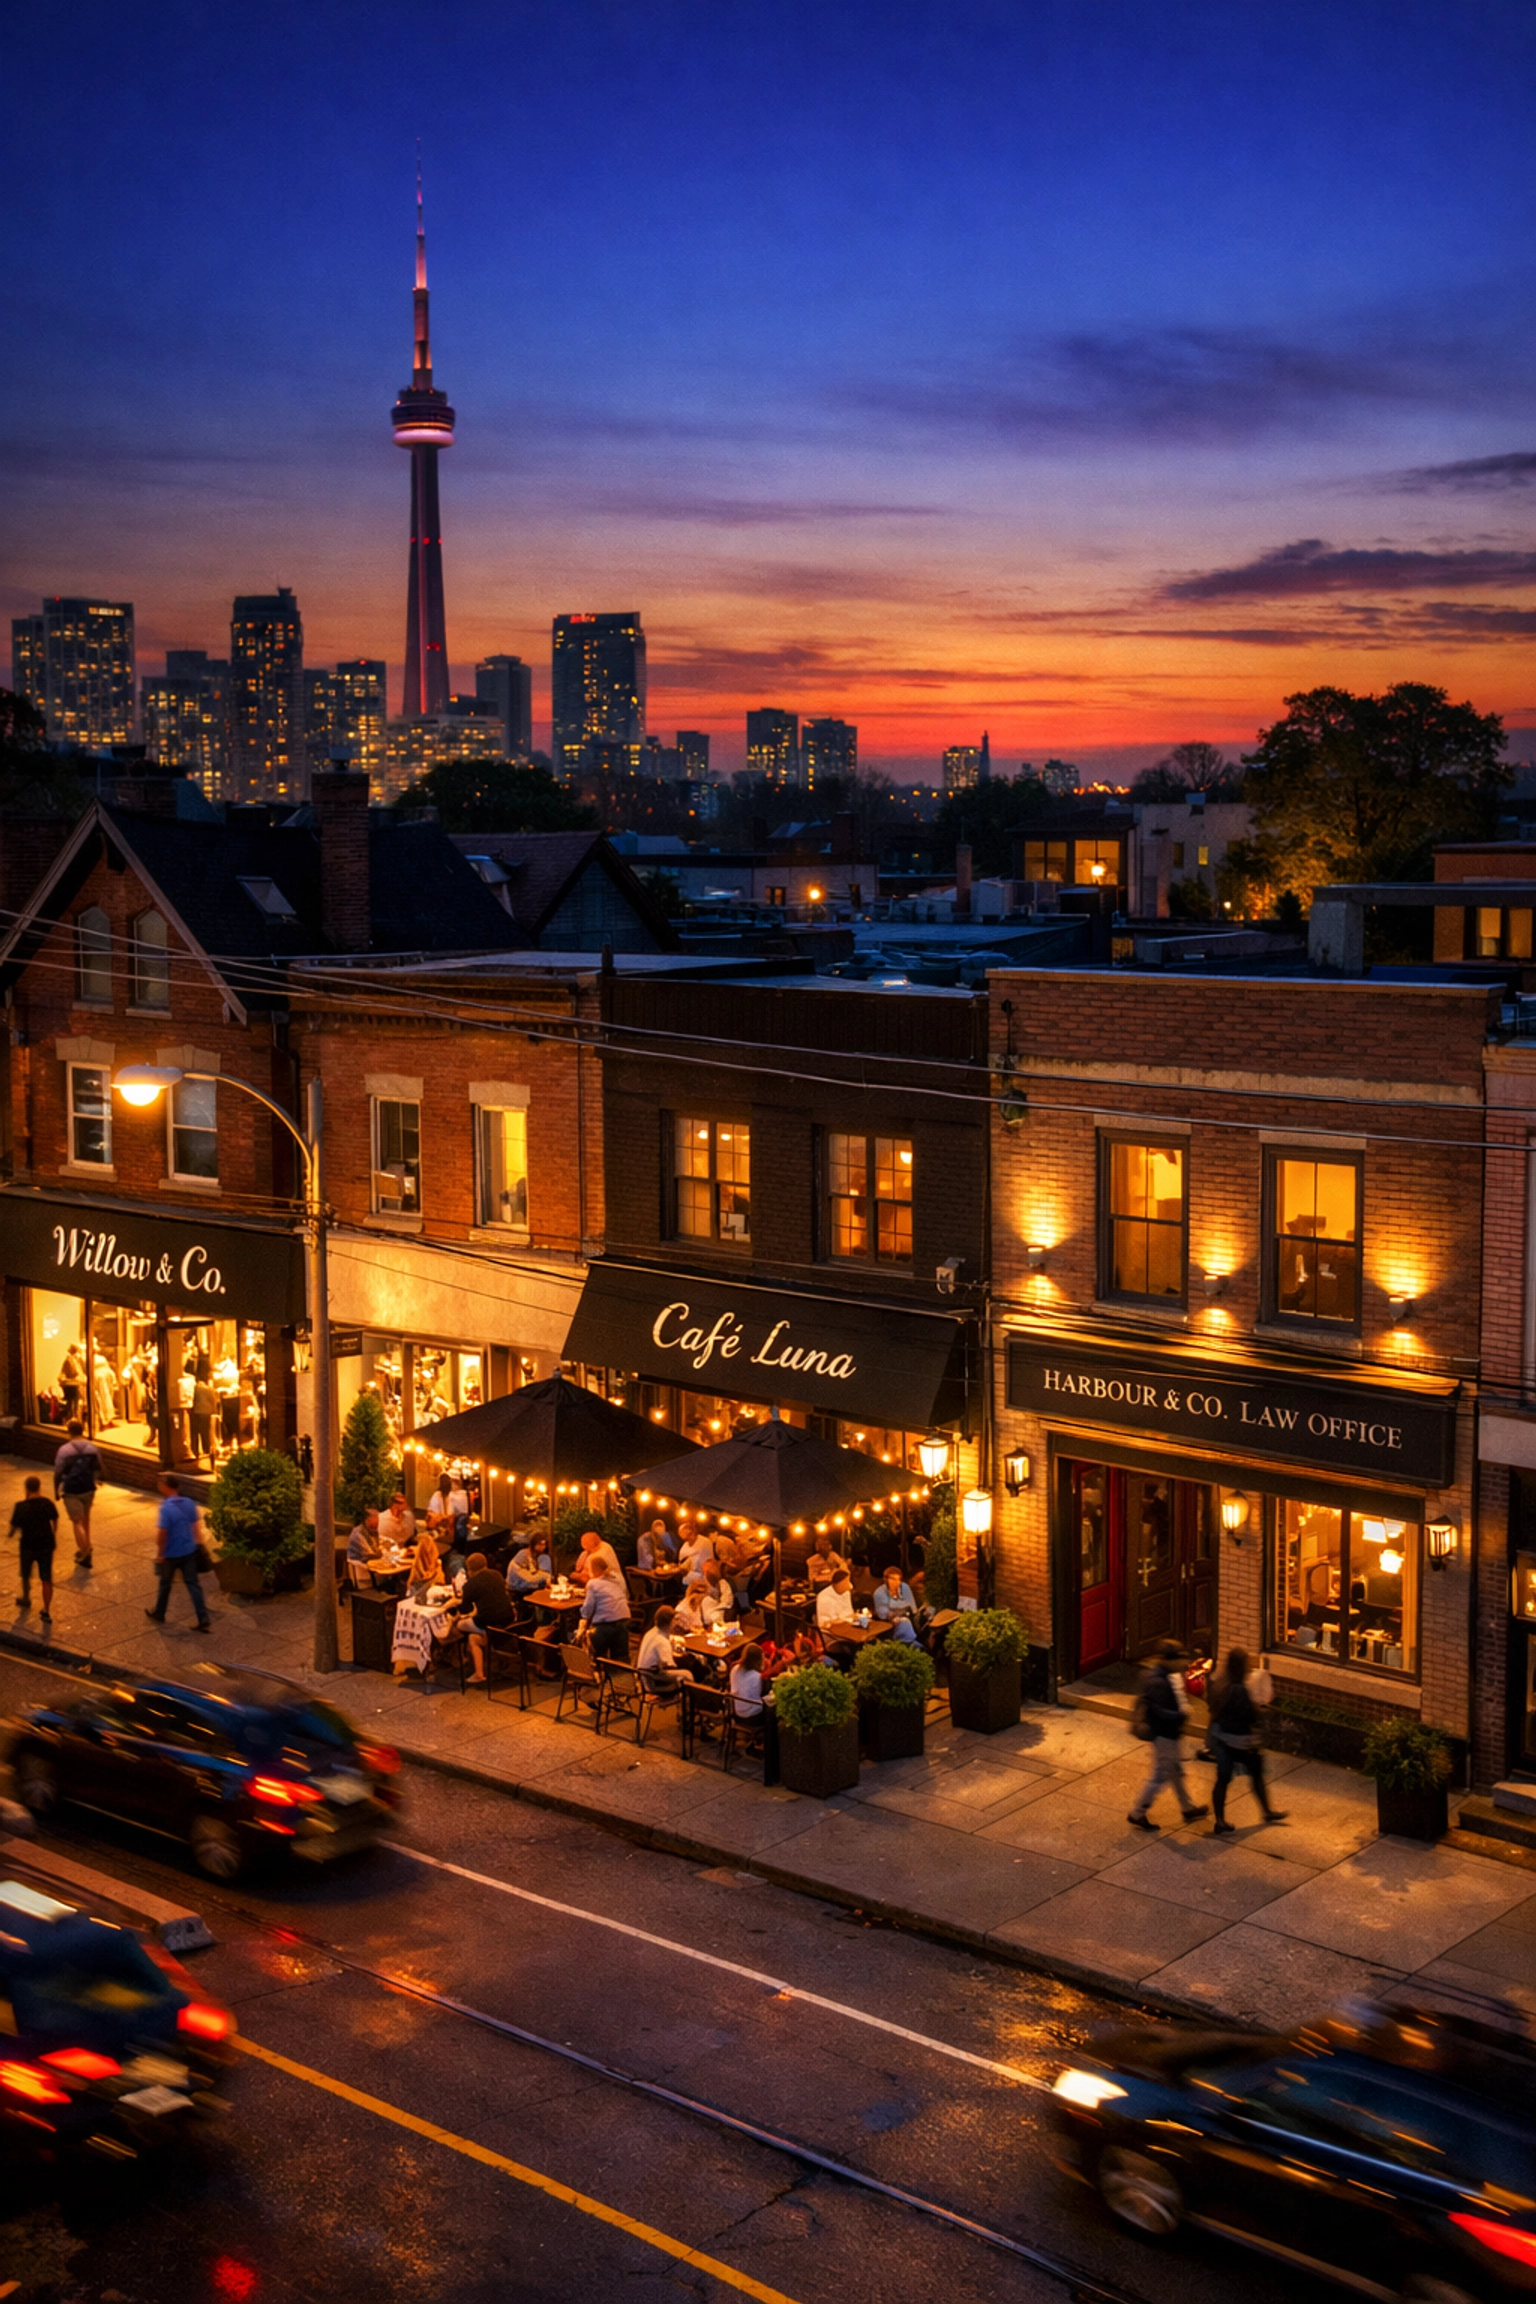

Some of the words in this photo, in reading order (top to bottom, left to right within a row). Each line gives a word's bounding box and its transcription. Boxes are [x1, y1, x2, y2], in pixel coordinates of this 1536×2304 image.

[53, 1225, 151, 1281] Willow
[156, 1253, 173, 1285] &
[180, 1246, 226, 1294] Co.
[652, 1302, 743, 1369] Café
[750, 1320, 856, 1379] Luna
[1043, 1369, 1158, 1408] HARBOUR
[1164, 1389, 1180, 1411] &
[1187, 1392, 1228, 1420] CO.
[1240, 1401, 1299, 1430] LAW
[1308, 1413, 1402, 1449] OFFICE
